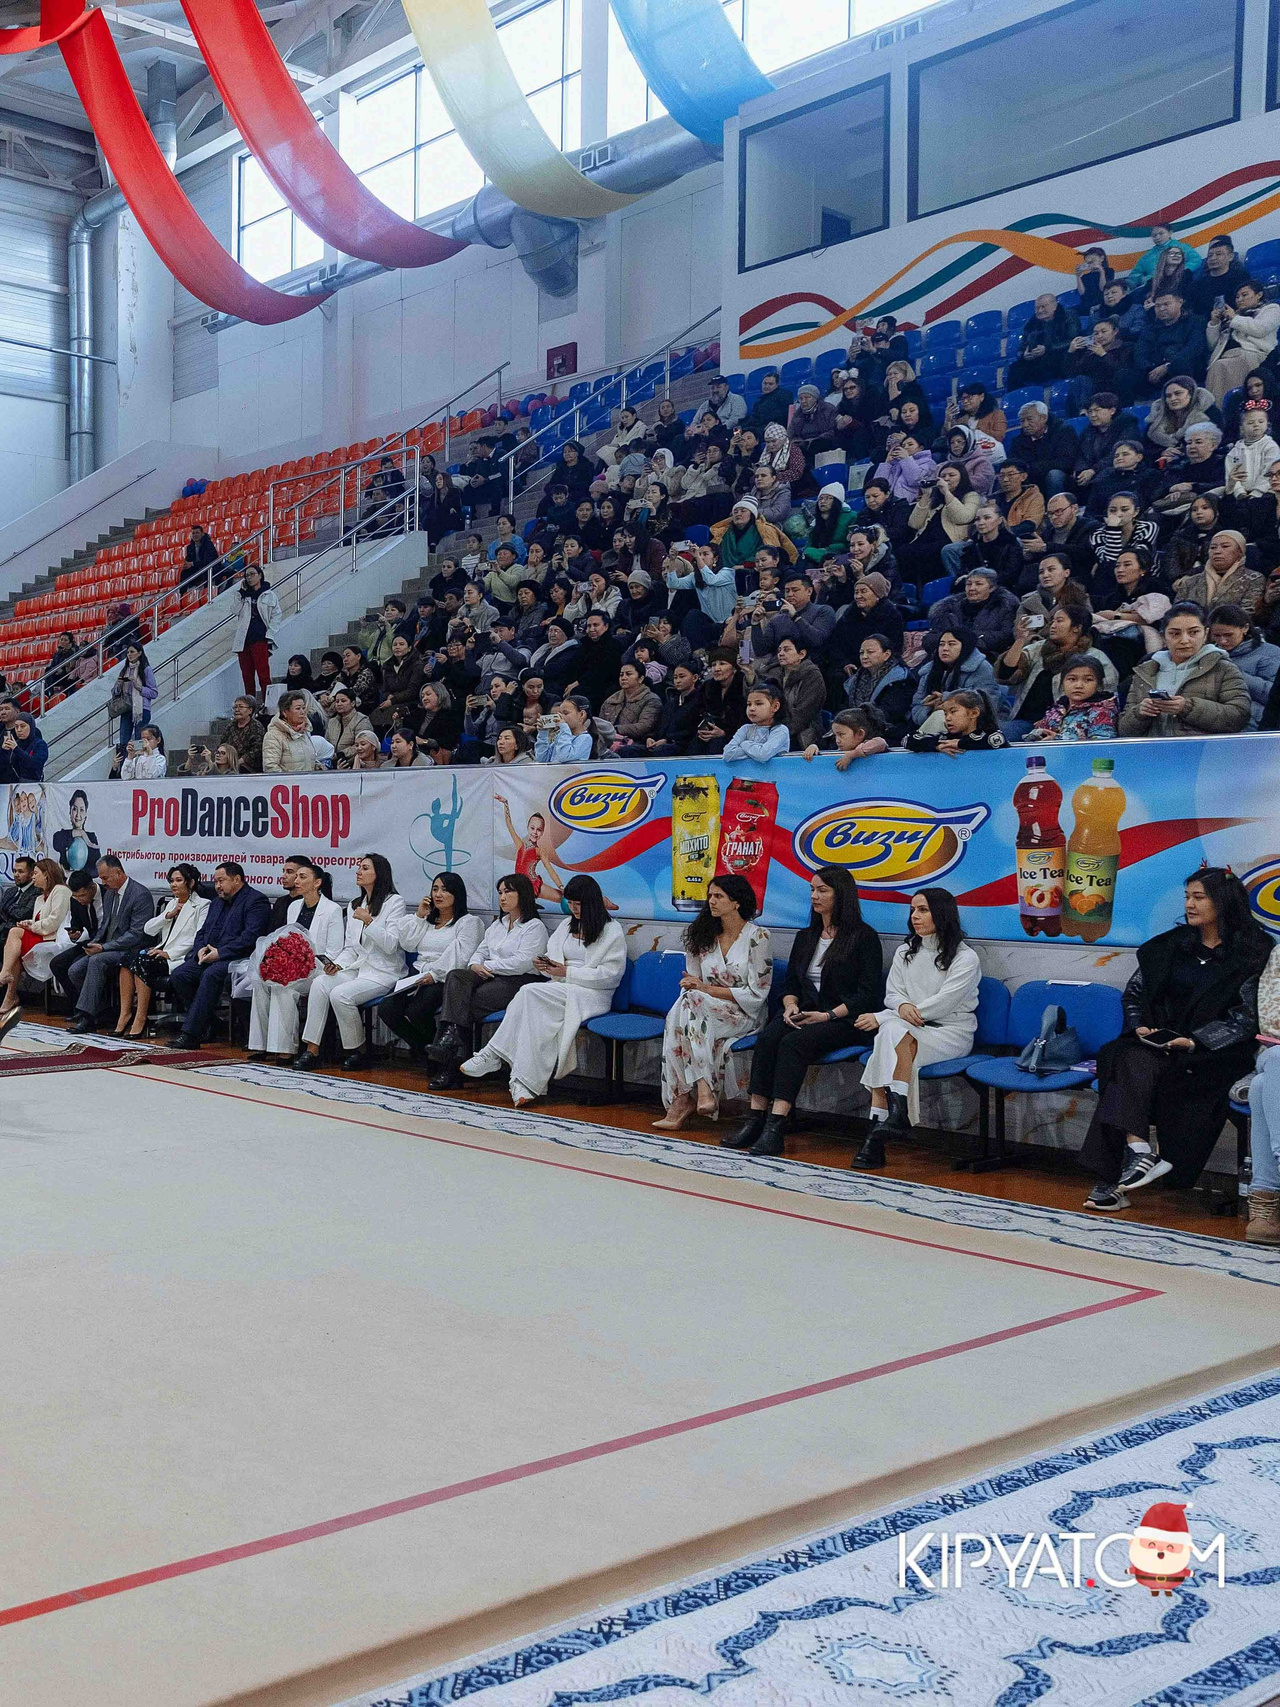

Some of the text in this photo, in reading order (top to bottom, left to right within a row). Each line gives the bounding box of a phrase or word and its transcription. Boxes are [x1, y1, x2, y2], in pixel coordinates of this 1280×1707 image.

[131, 784, 351, 848] ProDanceShop
[680, 835, 708, 854] МОХИТО
[726, 841, 760, 856] ГРАНАТ
[168, 851, 247, 864] производителей
[1019, 867, 1065, 879] Ice Tea
[1066, 869, 1112, 887] Ice Tea
